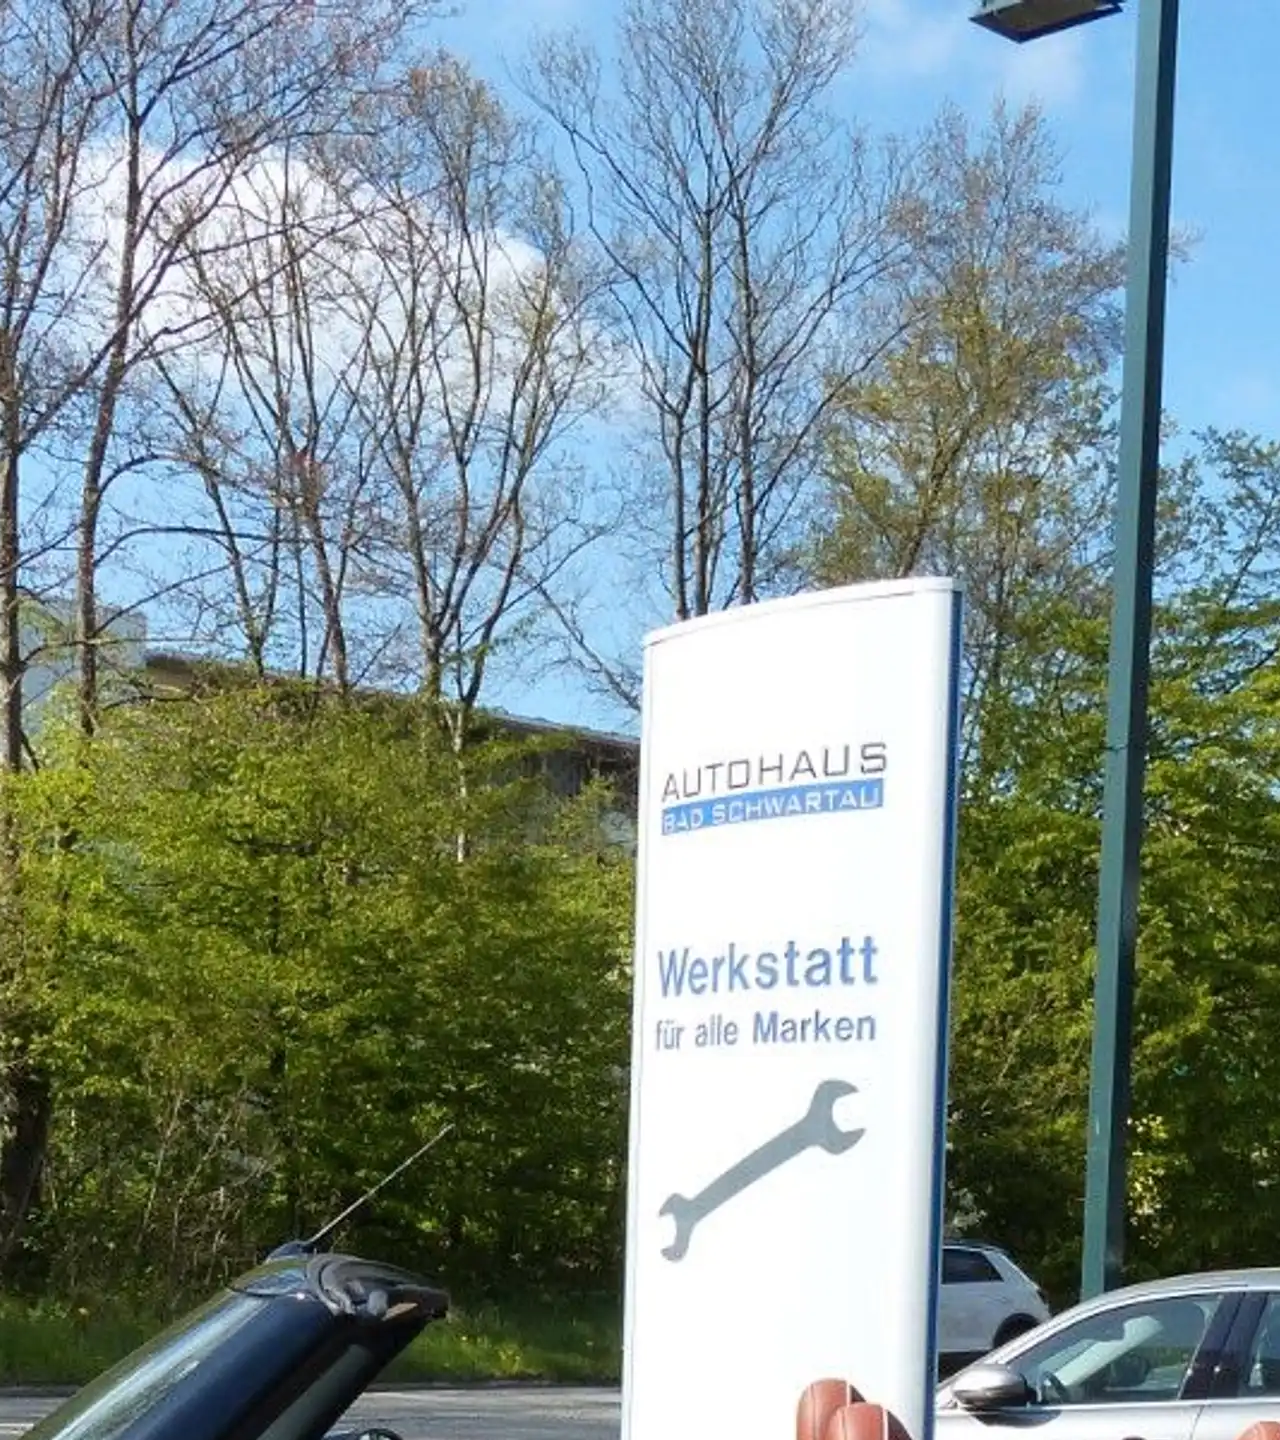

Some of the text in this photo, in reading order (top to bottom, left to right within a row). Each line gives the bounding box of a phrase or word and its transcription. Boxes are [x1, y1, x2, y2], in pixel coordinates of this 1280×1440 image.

[661, 741, 887, 803] AUTOHAUS
[664, 786, 880, 833] BAD SCHWARTAU
[657, 935, 879, 998] Werkstatt
[656, 1008, 876, 1051] für alle Marken
